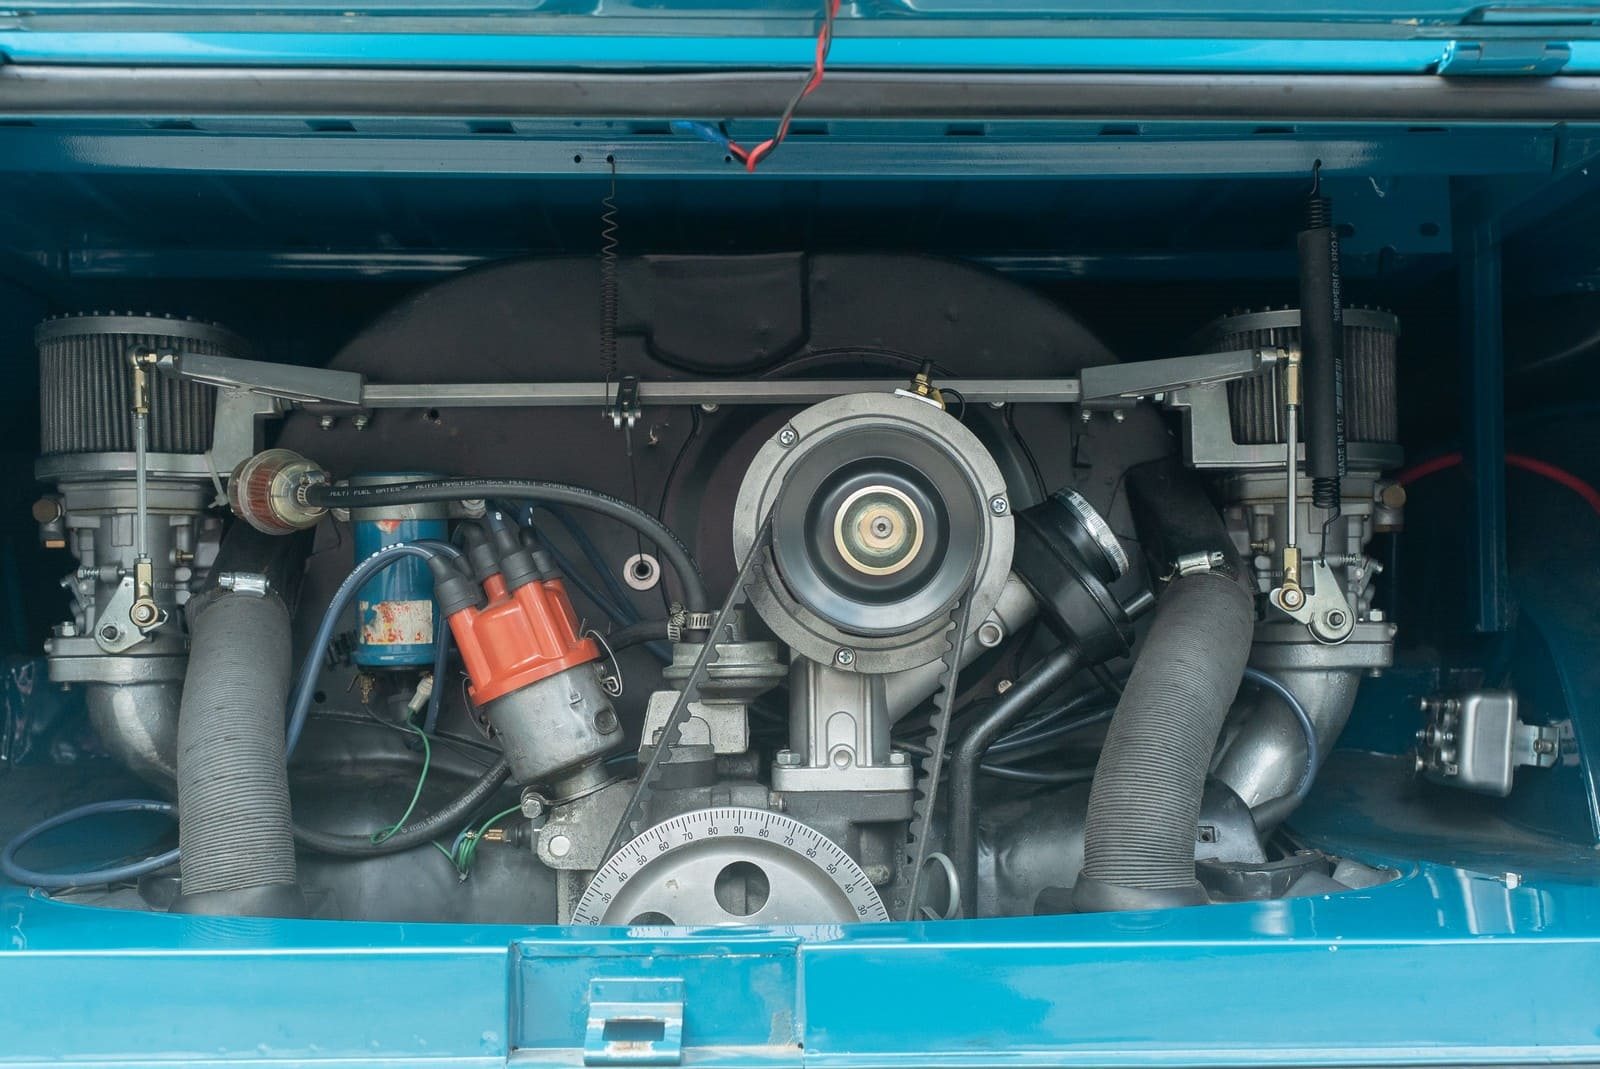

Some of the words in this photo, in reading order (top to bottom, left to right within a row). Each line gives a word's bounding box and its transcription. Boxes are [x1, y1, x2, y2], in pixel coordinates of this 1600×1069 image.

[1337, 435, 1345, 445] IN
[1337, 447, 1345, 477] MADE
[588, 915, 600, 926] 20
[601, 892, 613, 905] 30
[617, 872, 629, 884] 40
[636, 854, 648, 867] 50
[658, 841, 670, 852] 60
[682, 831, 694, 842] 70
[707, 826, 719, 836] 80
[733, 825, 745, 834] 90
[758, 829, 770, 839] 80
[784, 836, 794, 847] 70
[805, 848, 817, 859] 60
[825, 863, 838, 875] 50
[843, 883, 855, 895] 40
[857, 904, 868, 917] 30
